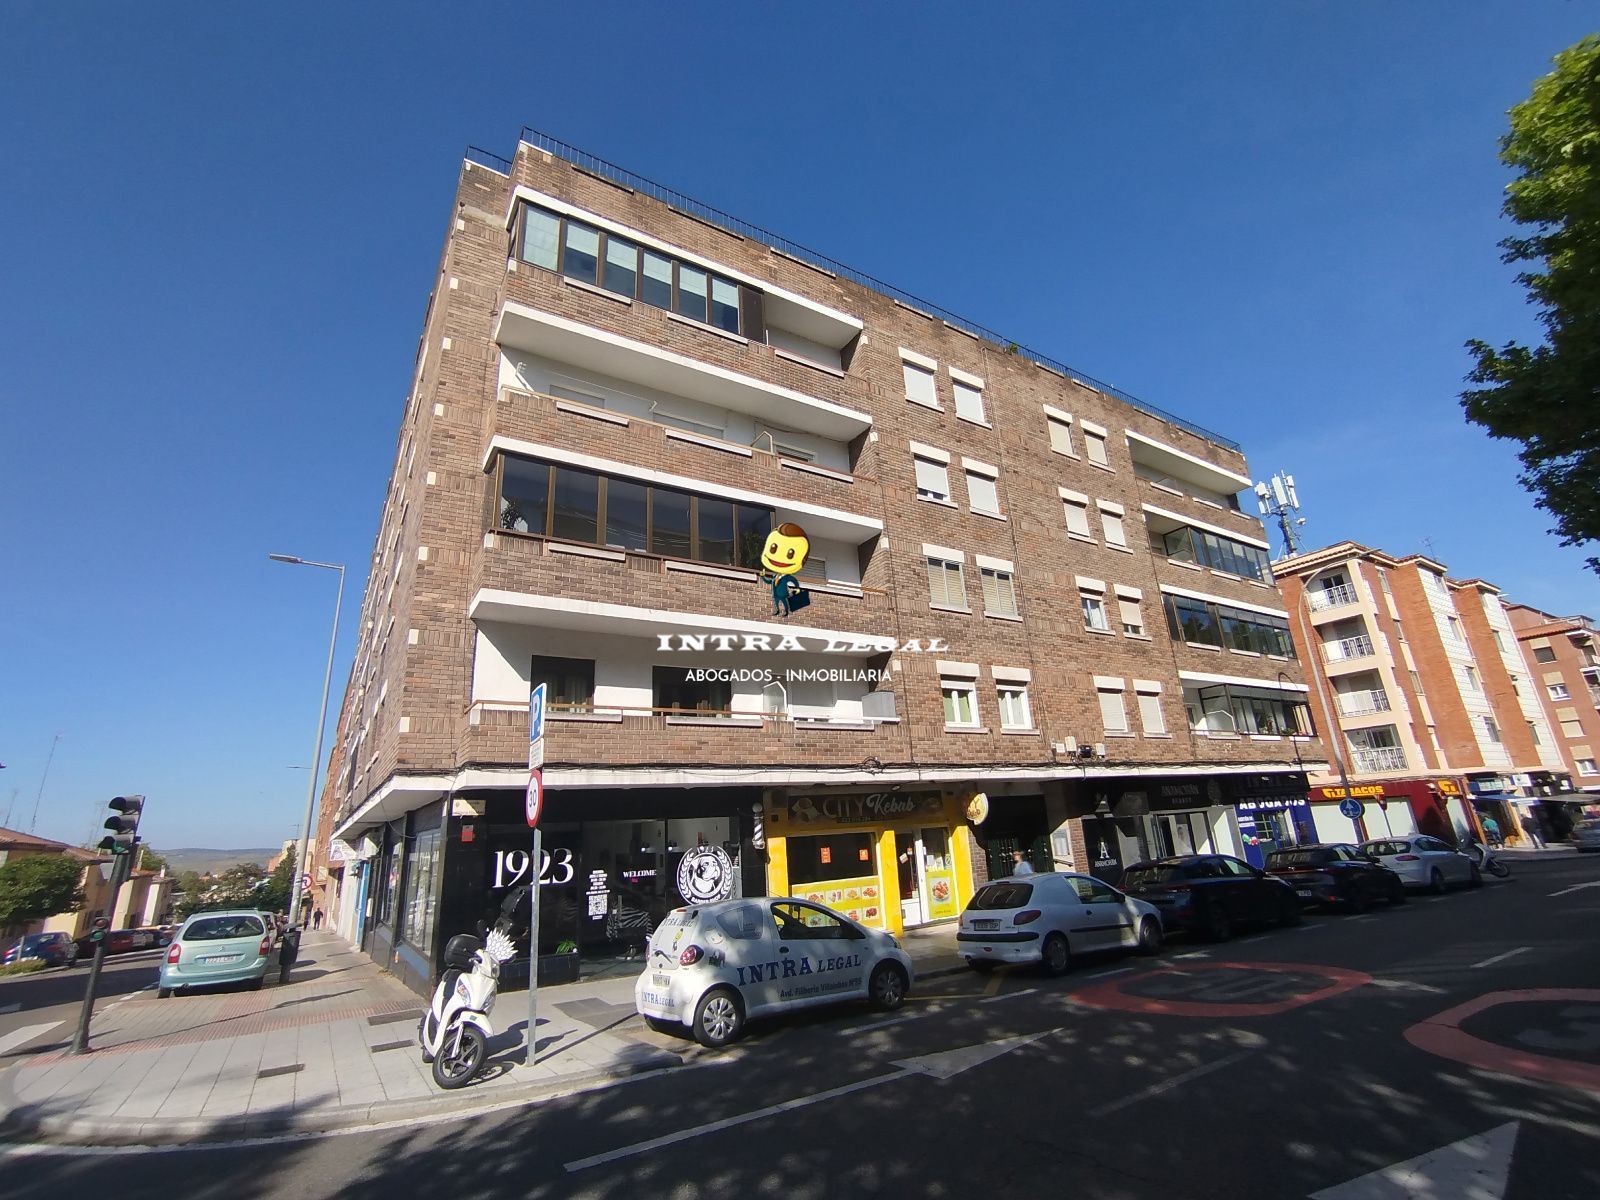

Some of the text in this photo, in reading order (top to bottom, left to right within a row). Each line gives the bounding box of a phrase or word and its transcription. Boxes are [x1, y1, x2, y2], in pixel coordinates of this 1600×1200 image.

[532, 693, 541, 737] P
[528, 790, 537, 808] 30
[822, 793, 917, 818] CITY Kebab
[492, 848, 574, 888] 1923
[623, 869, 657, 878] WELCOME
[737, 954, 862, 986] INTRA LEGAL
[641, 991, 659, 1005] INTRA
